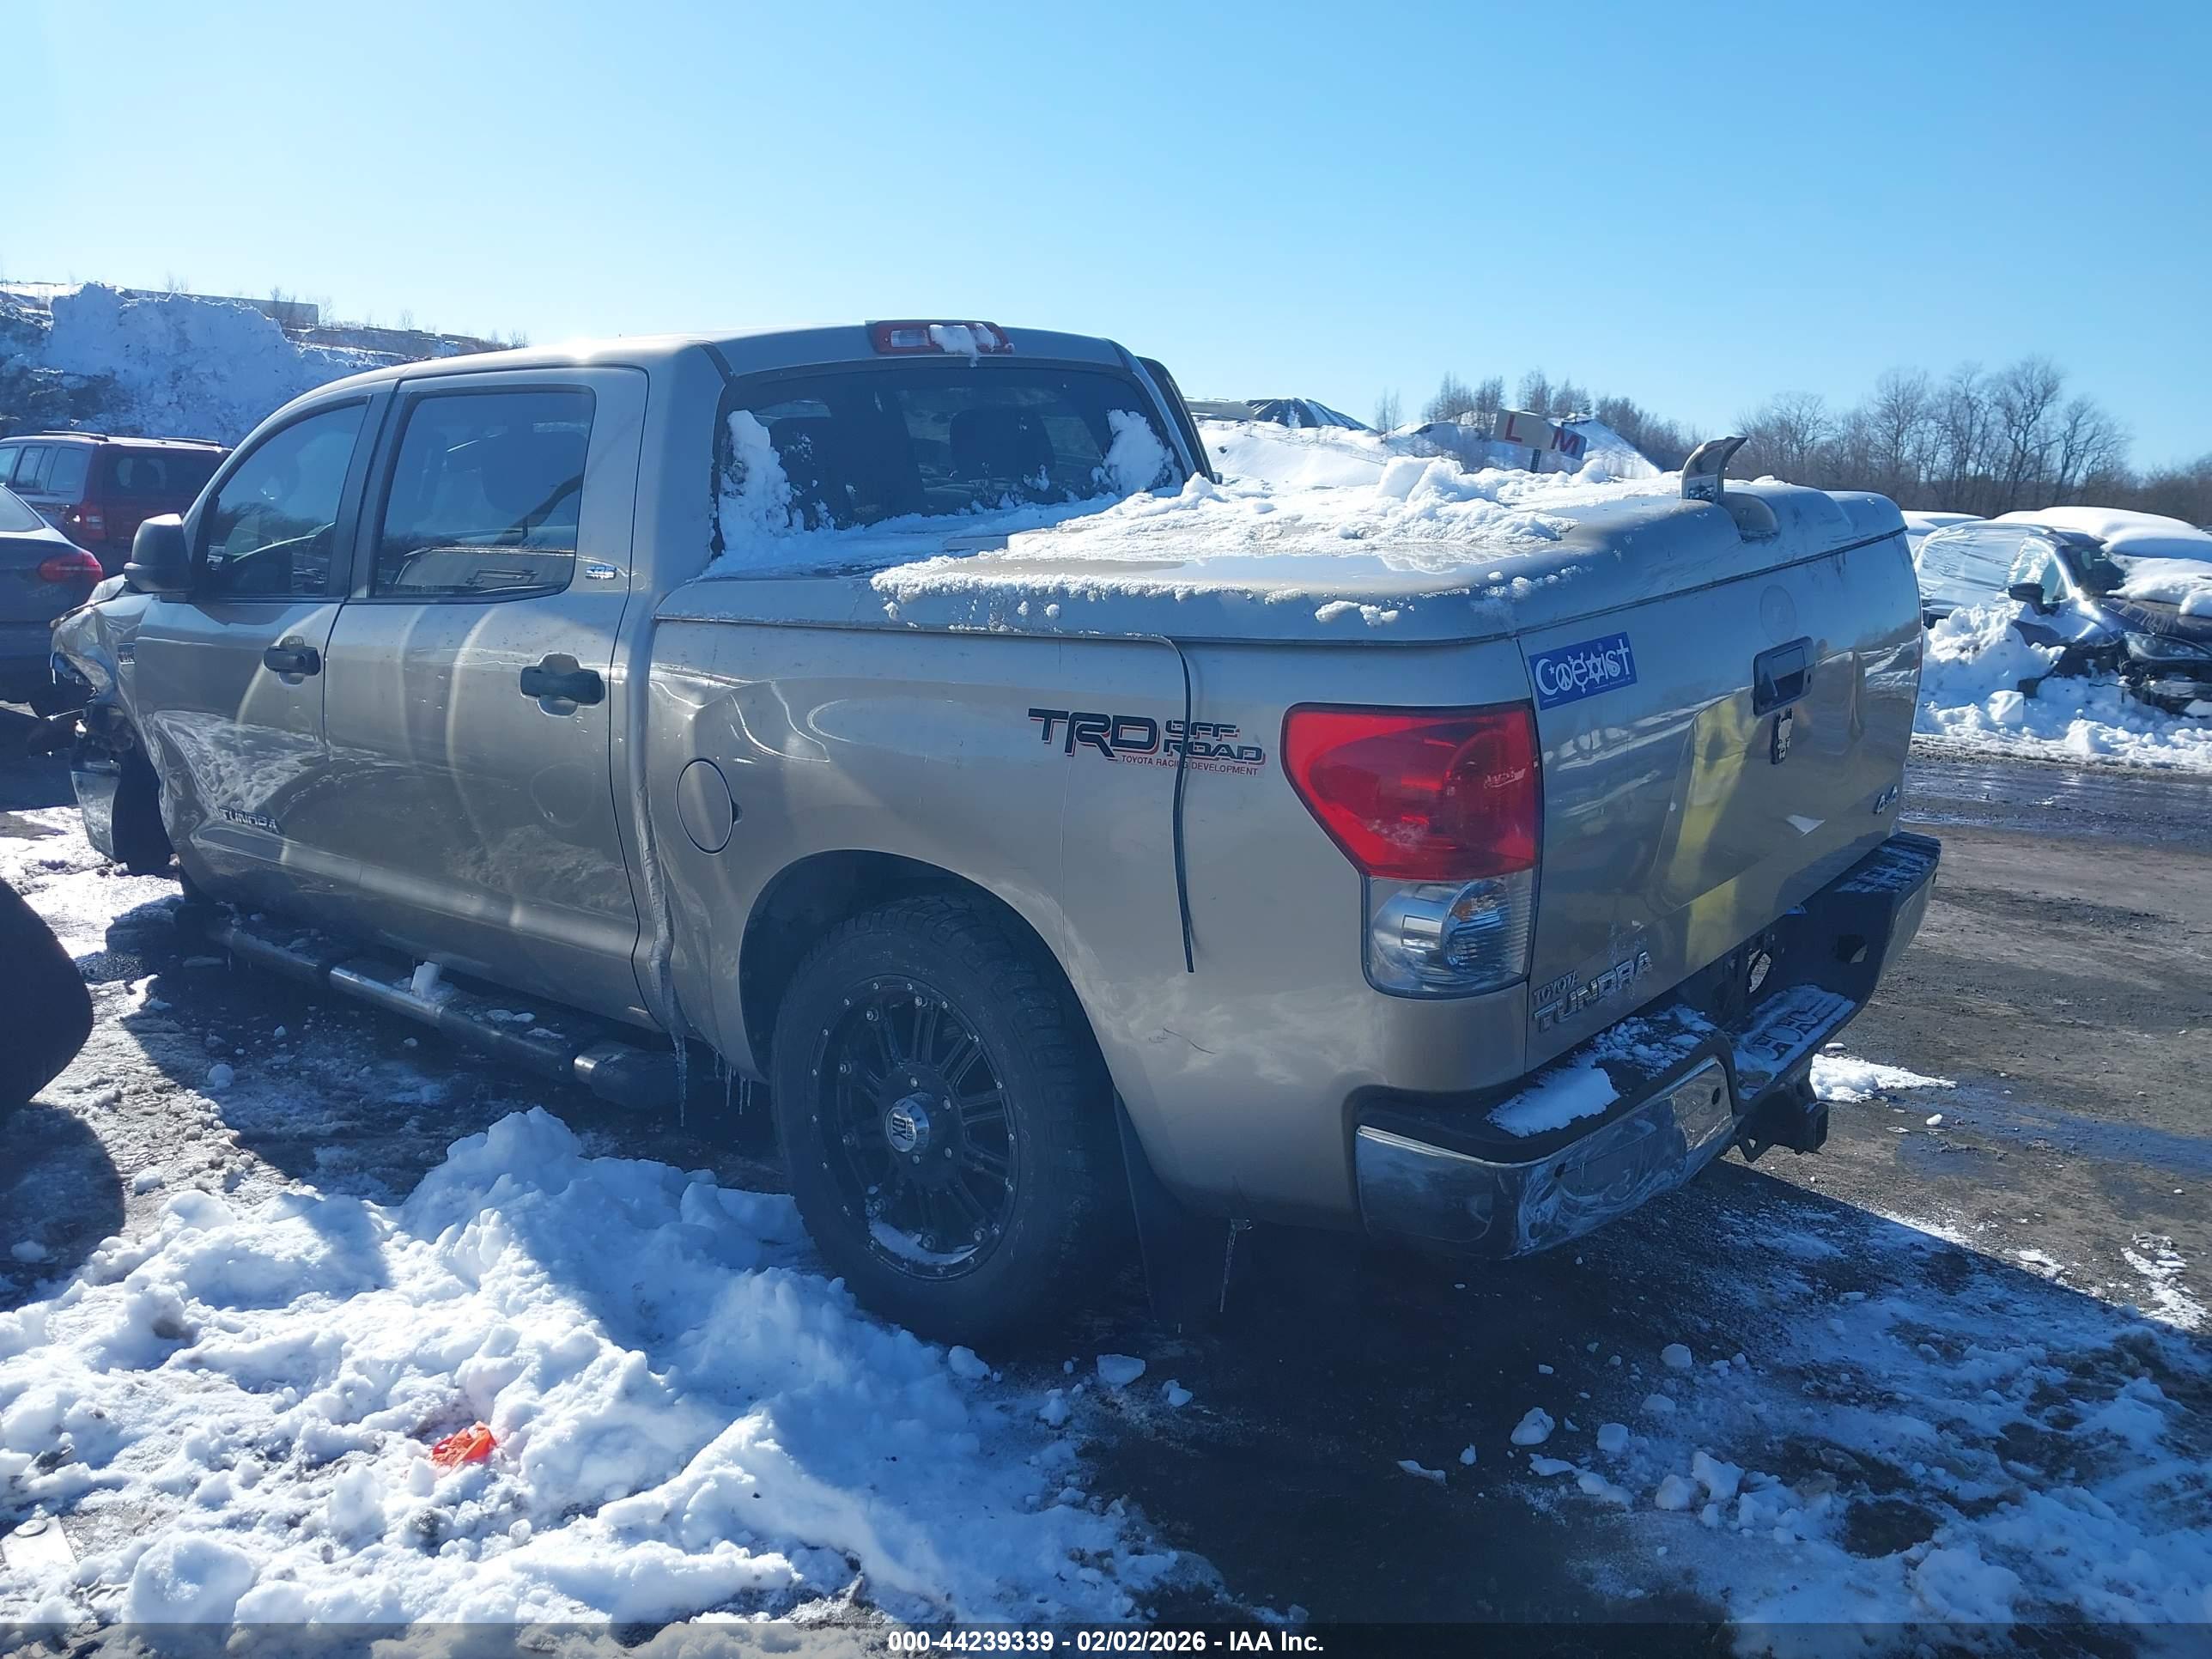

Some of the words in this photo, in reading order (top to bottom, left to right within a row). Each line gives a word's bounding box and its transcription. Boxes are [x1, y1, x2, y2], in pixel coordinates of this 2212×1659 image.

[1504, 414, 1522, 443] L
[1550, 426, 1581, 456] M
[1028, 708, 1159, 759] TRD
[1164, 720, 1239, 741] OFF
[1121, 755, 1153, 767] TOYOTA
[1156, 758, 1188, 769] RACIG
[1191, 762, 1258, 776] DEVELOPMENT
[1163, 738, 1266, 764] ROAD
[220, 807, 284, 836] TUNDRA
[1532, 969, 1580, 1005] TOYOTA
[1534, 951, 1653, 1031] TUNDRA
[892, 1117, 907, 1140] XD
[906, 1120, 915, 1142] SERIES
